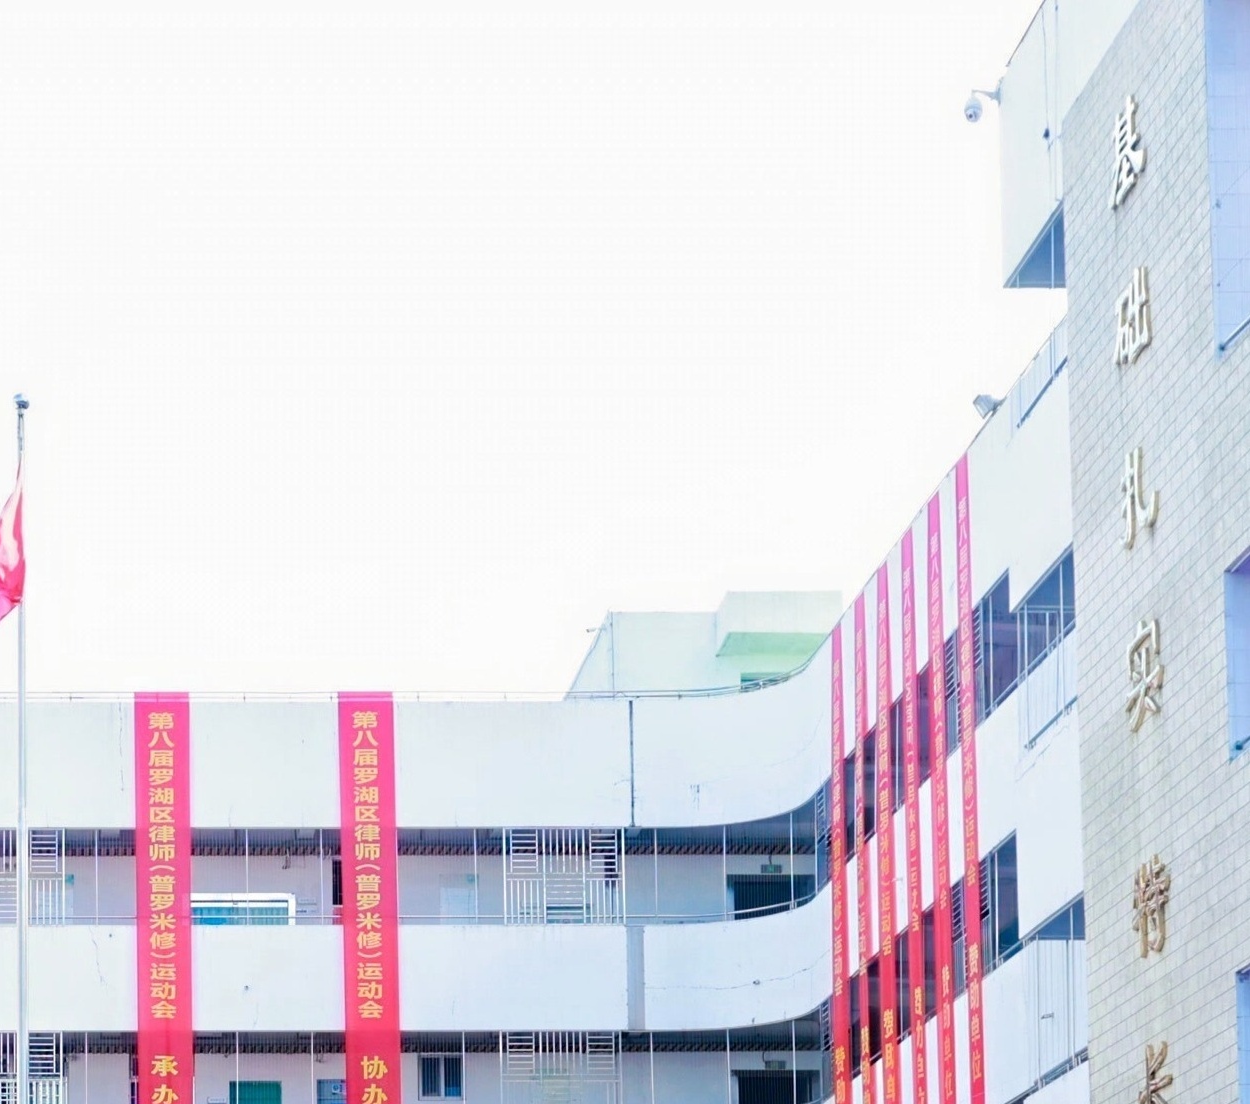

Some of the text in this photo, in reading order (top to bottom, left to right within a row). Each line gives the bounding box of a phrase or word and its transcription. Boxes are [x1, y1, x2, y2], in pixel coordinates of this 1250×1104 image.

[1108, 94, 1164, 732] 基础扎实
[148, 712, 177, 1020] 第八届罗湖区律师（普罗米修）运动会
[352, 711, 383, 1019] 第八届罗湖区律师（普罗米修）运动会
